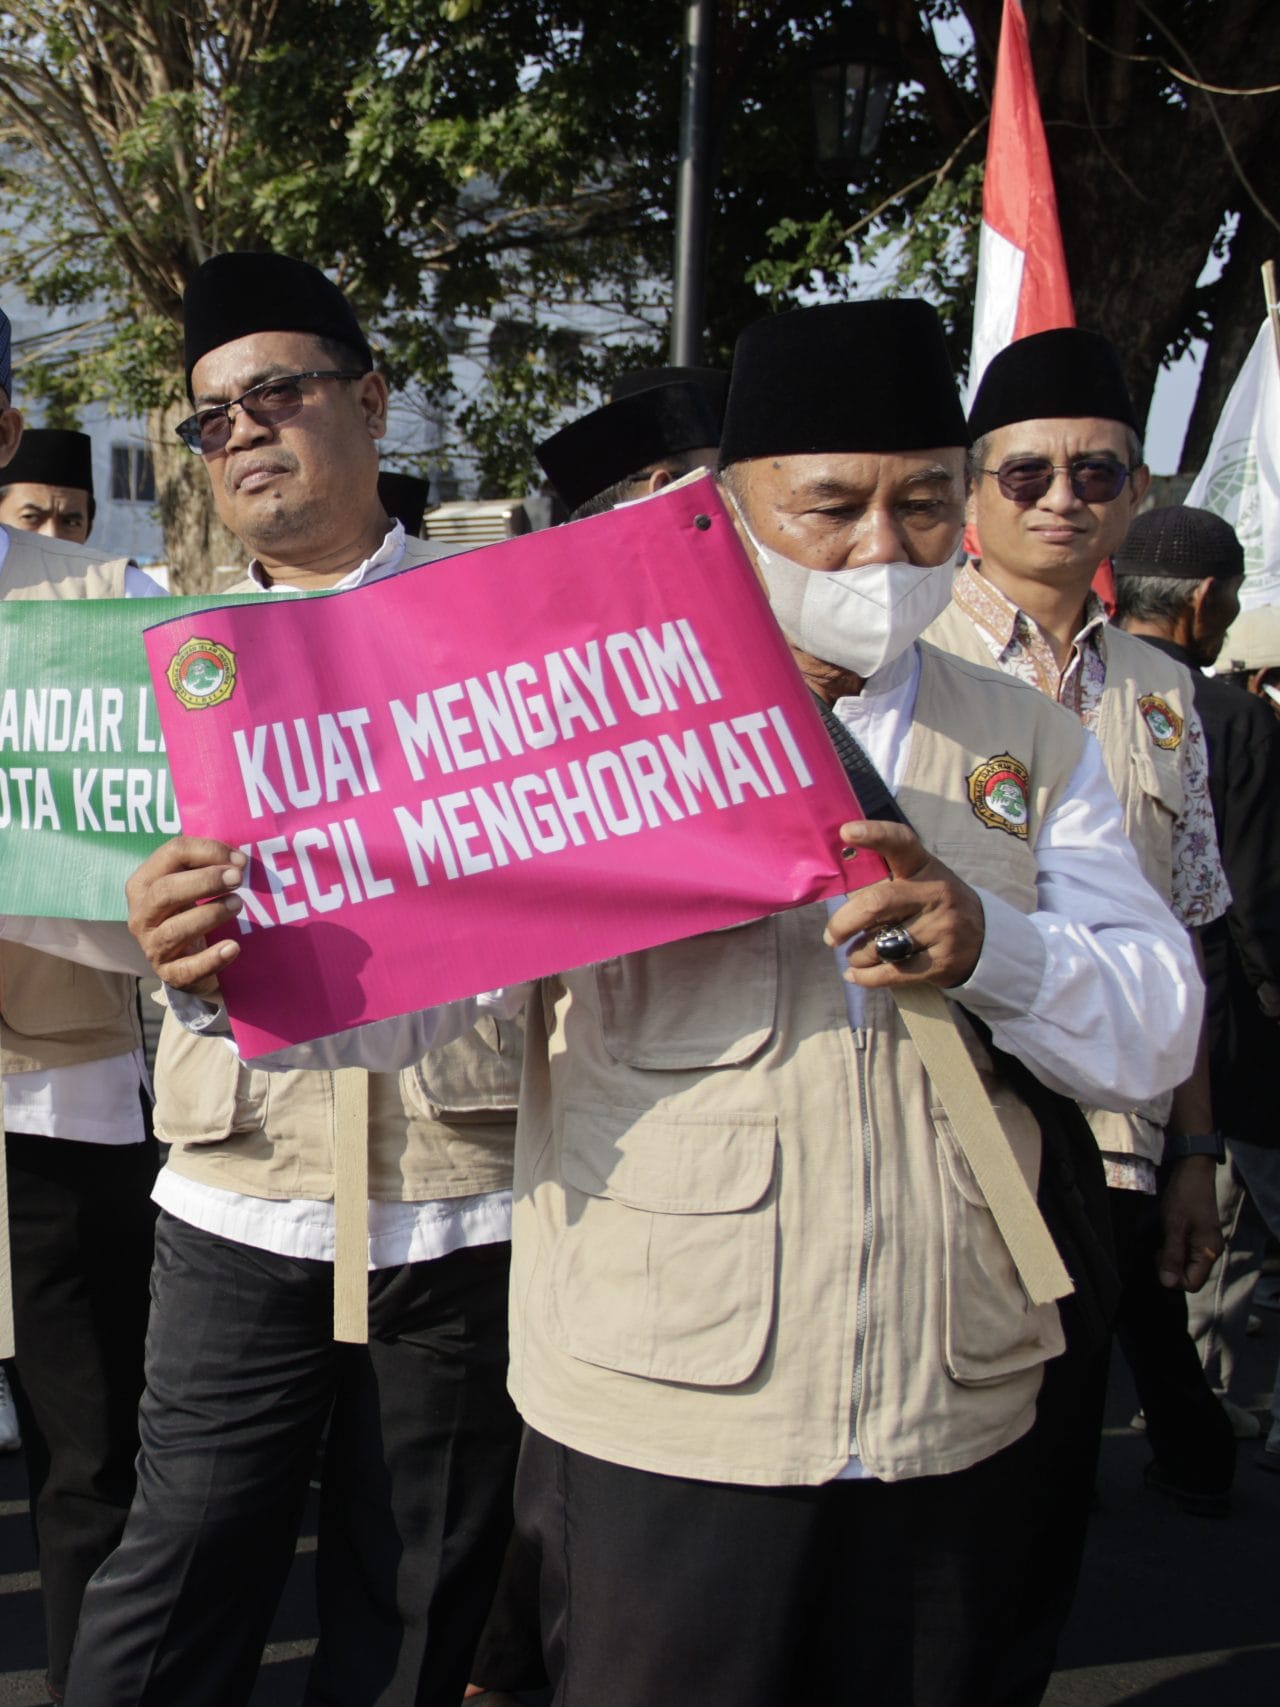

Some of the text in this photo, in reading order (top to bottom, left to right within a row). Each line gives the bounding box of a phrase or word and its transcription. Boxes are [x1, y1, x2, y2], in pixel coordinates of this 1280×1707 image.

[73, 768, 182, 834] KERU
[233, 618, 722, 819] KUAT MENGAYOMI
[236, 706, 815, 935] KECIL MENGHORMATI
